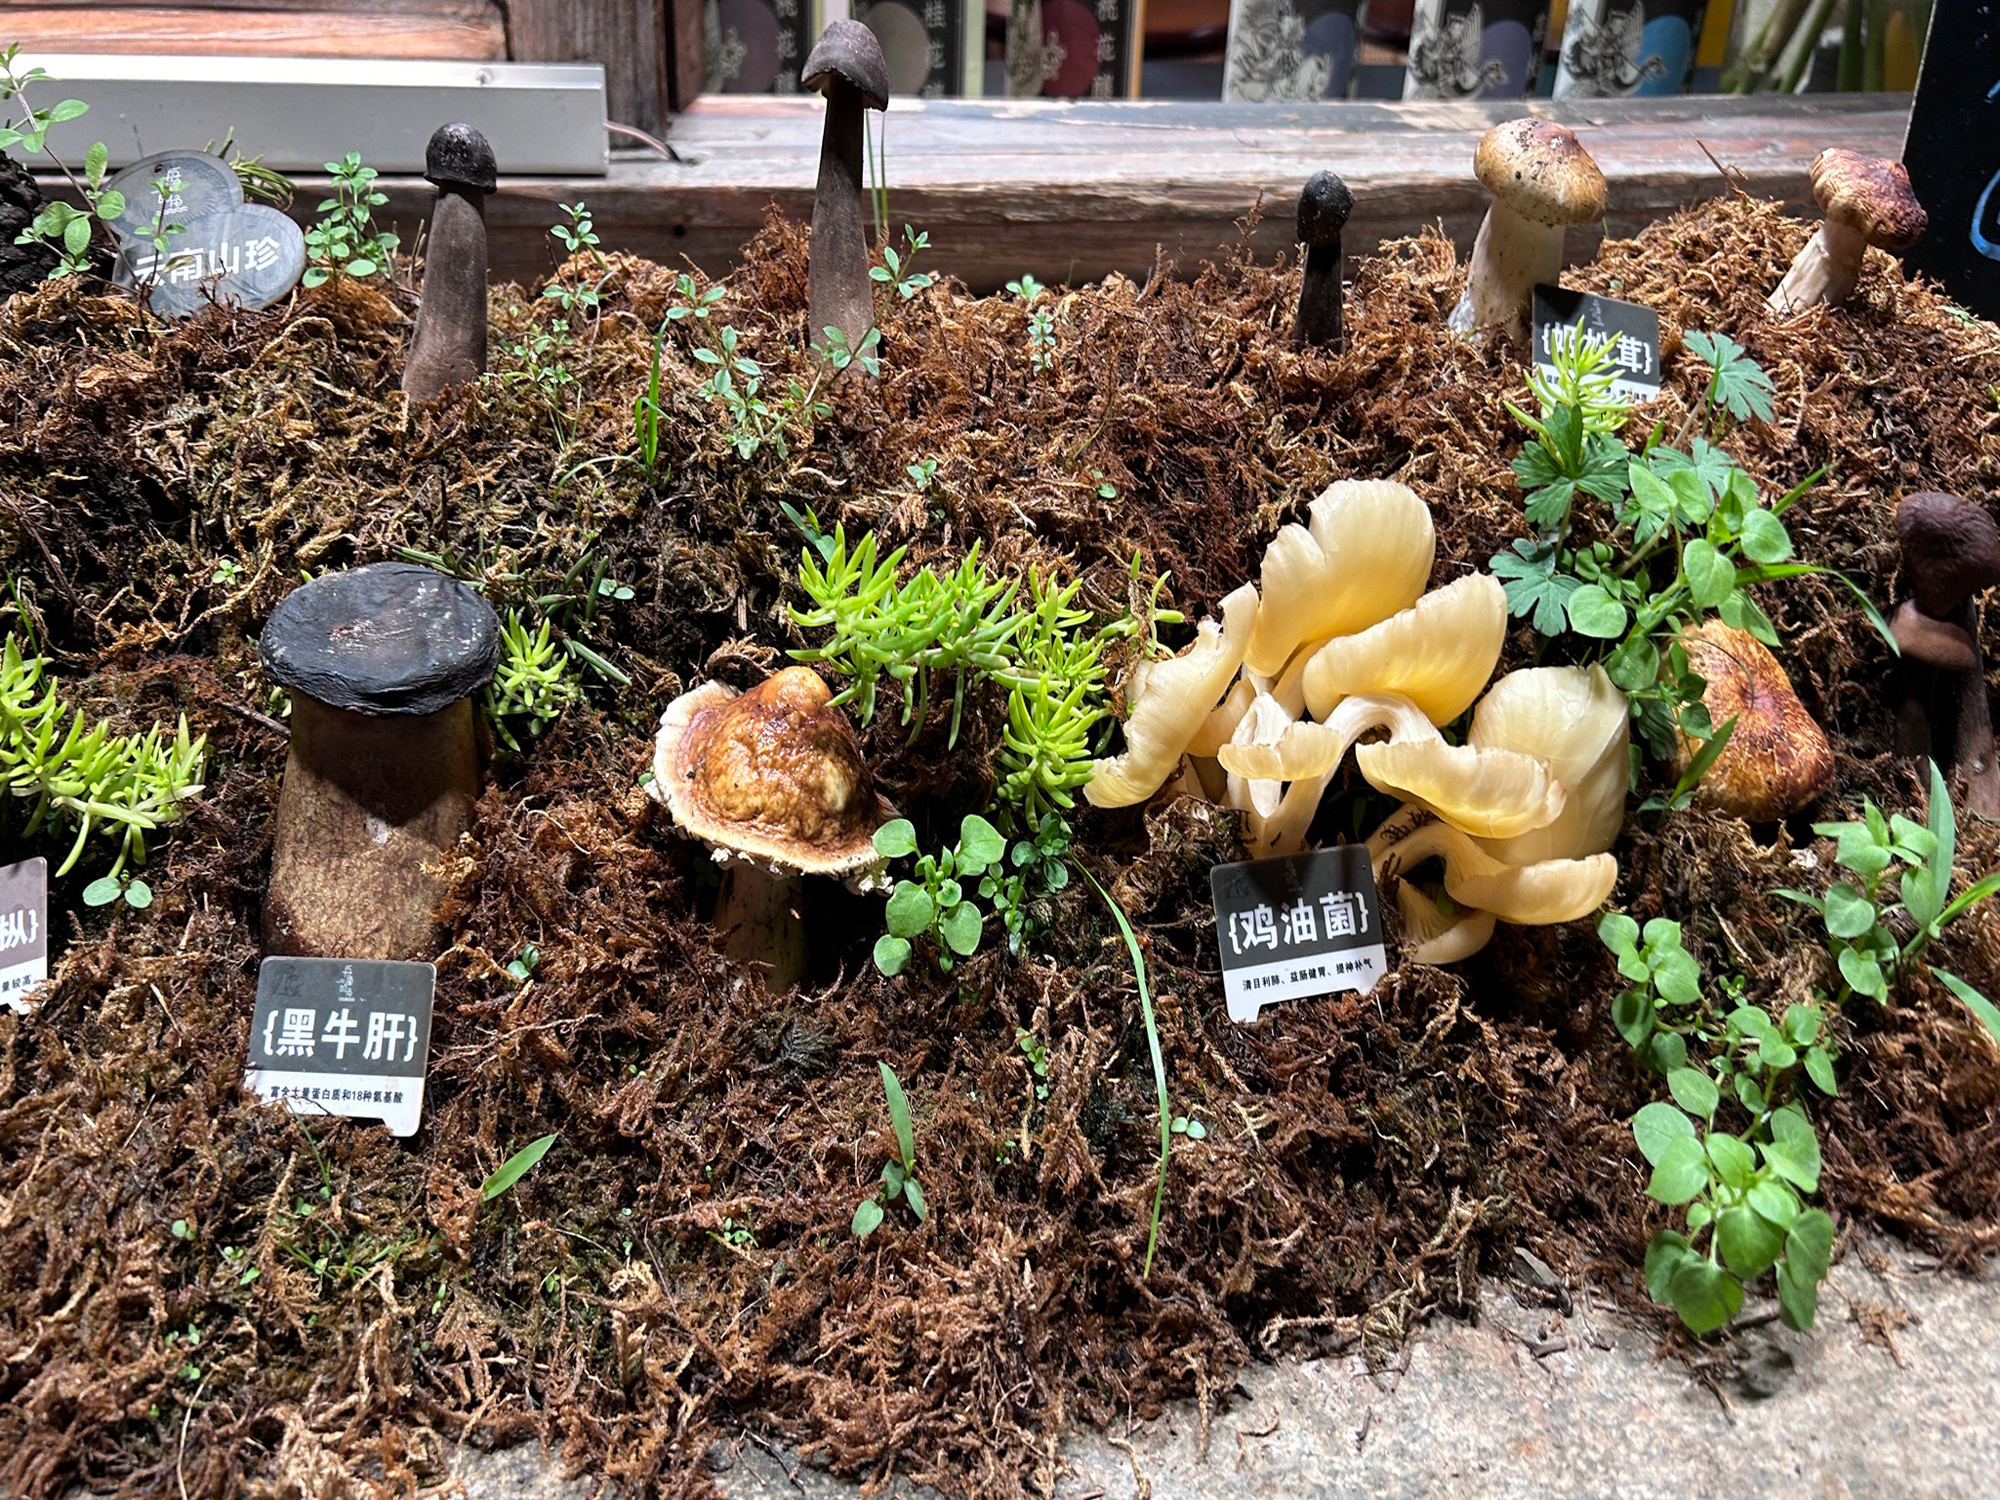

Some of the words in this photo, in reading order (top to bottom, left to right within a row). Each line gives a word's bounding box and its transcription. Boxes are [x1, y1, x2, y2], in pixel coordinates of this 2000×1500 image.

[133, 235, 281, 288] 云南山珍
[1228, 890, 1369, 955] {鸡油菌}
[262, 1008, 418, 1061] {黑牛肝}
